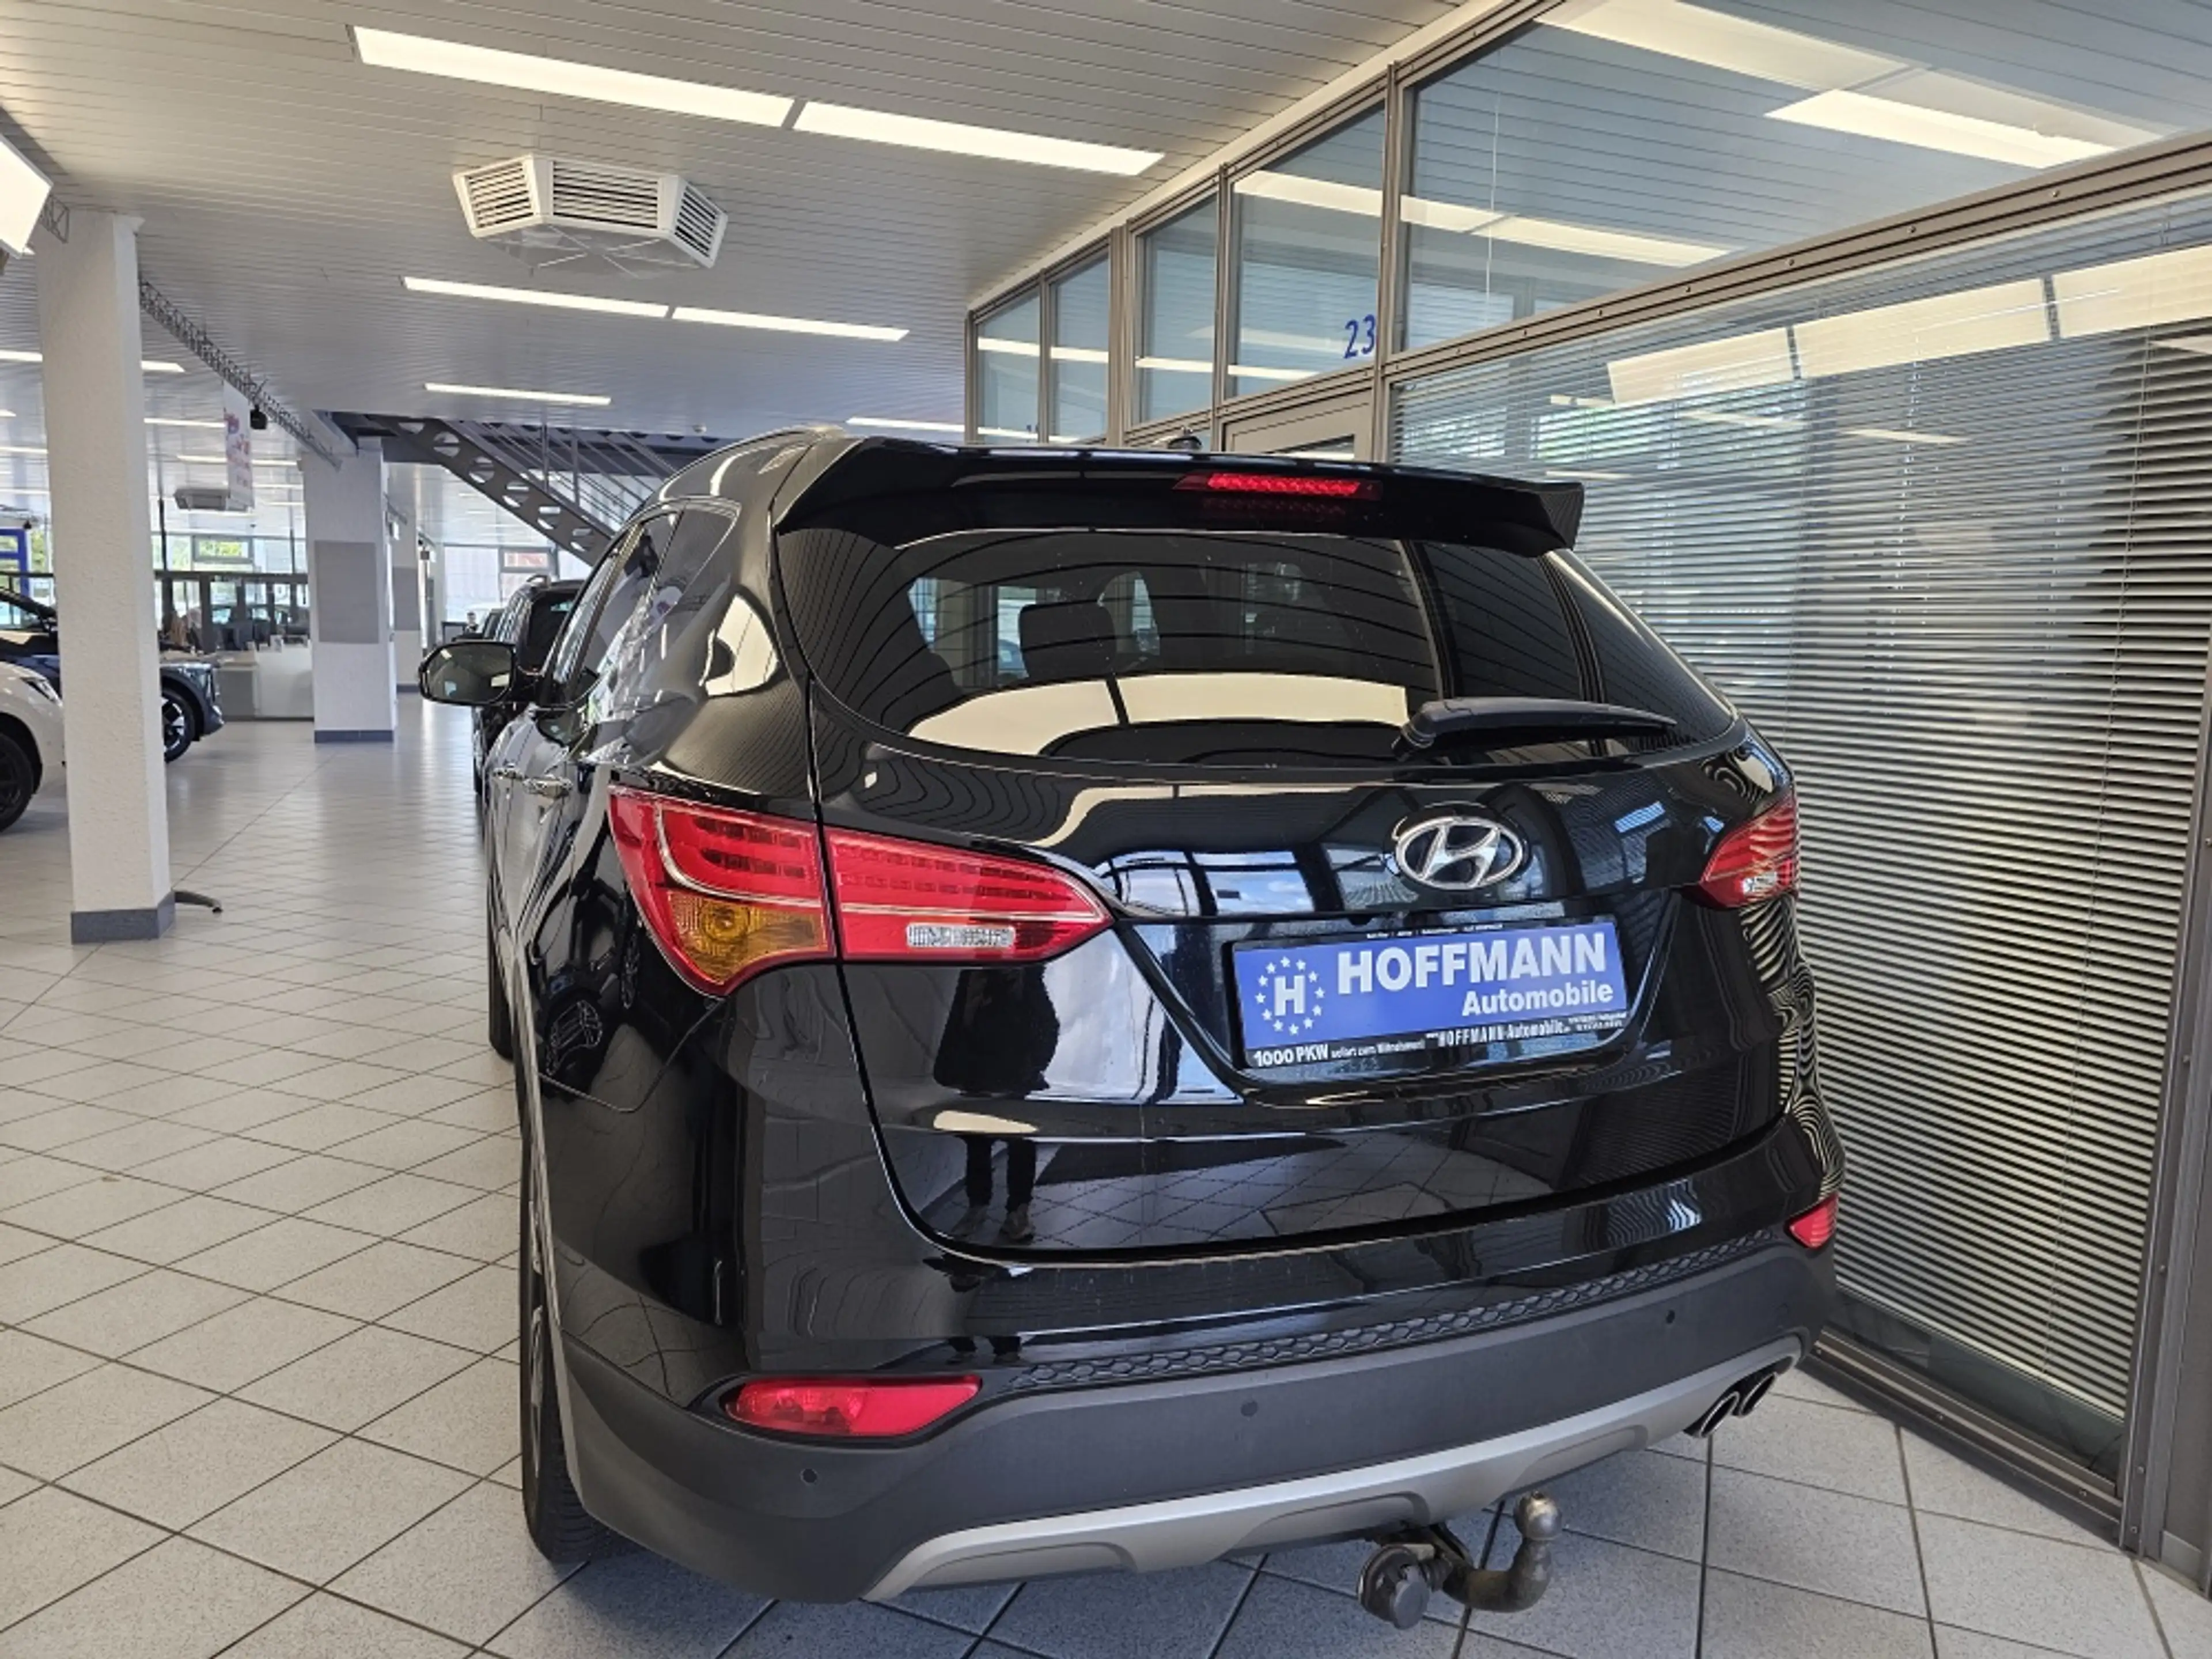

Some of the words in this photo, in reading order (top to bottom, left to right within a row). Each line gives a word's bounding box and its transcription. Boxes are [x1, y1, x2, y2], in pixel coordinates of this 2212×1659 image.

[1343, 314, 1376, 359] 23
[1337, 931, 1607, 995] HOFFMANN
[1274, 975, 1306, 1017] H
[1461, 979, 1614, 1017] Automobile
[1253, 1047, 1294, 1067] 1000
[1296, 1043, 1328, 1063] PKW
